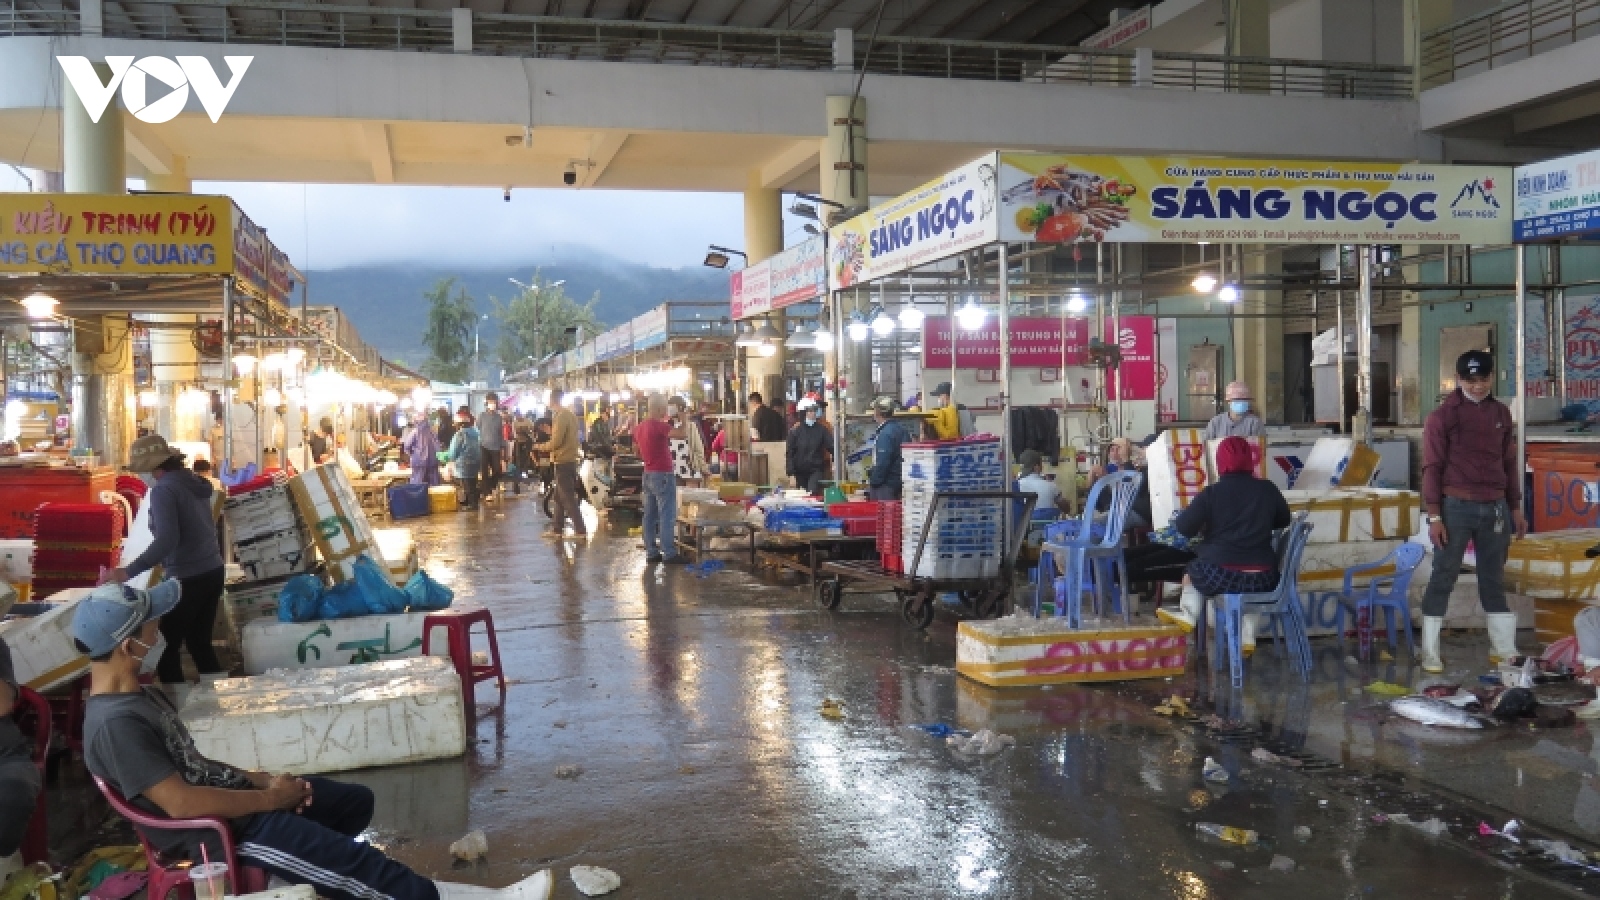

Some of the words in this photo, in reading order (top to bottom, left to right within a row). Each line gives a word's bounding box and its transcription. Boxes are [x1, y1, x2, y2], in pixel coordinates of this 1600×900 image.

[870, 216, 914, 259] SÁNG
[917, 189, 975, 239] NGỌC
[1152, 179, 1291, 220] SÁNG
[1304, 189, 1438, 229] NGỌC
[35, 237, 71, 266] CÁ
[75, 241, 125, 270] THỌ
[133, 241, 216, 266] QUANG
